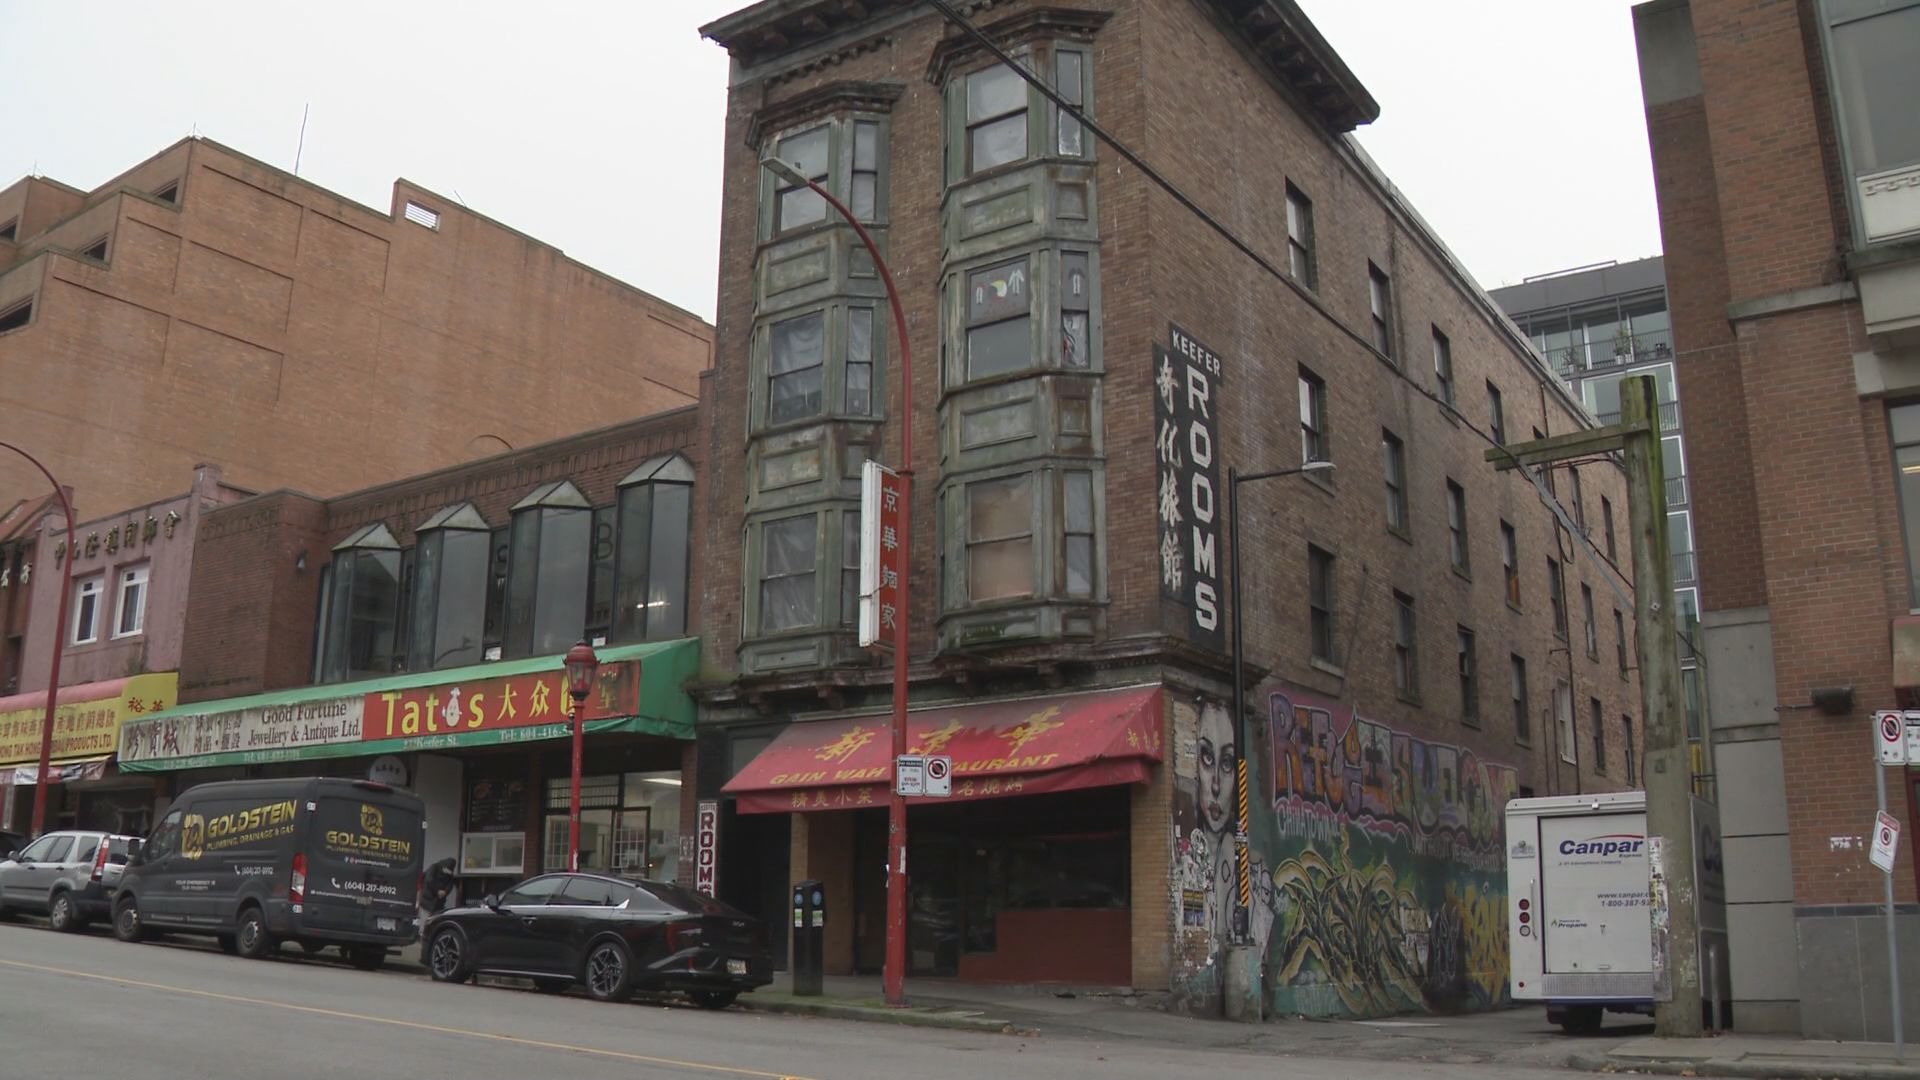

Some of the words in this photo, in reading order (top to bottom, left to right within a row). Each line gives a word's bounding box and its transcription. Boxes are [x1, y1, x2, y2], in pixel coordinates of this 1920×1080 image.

[1172, 330, 1221, 377] KEEFER
[1187, 364, 1218, 631] ROOMS
[262, 704, 293, 725] Good
[297, 703, 347, 721] Fortune
[67, 735, 98, 751] PRODUCTS
[248, 727, 289, 747] Jewellery
[290, 726, 299, 742] &
[301, 722, 338, 743] Antique
[341, 719, 360, 738] Ltd.
[769, 771, 827, 785] GAIN
[833, 766, 887, 781] WAH
[207, 799, 297, 838] GOLDSTEIN
[326, 831, 411, 855] GOLDSTEIN
[1559, 840, 1643, 856] Canpar
[344, 880, 365, 892] (604)
[366, 883, 397, 896] 217-8992
[1597, 892, 1650, 900] www.canpar.c
